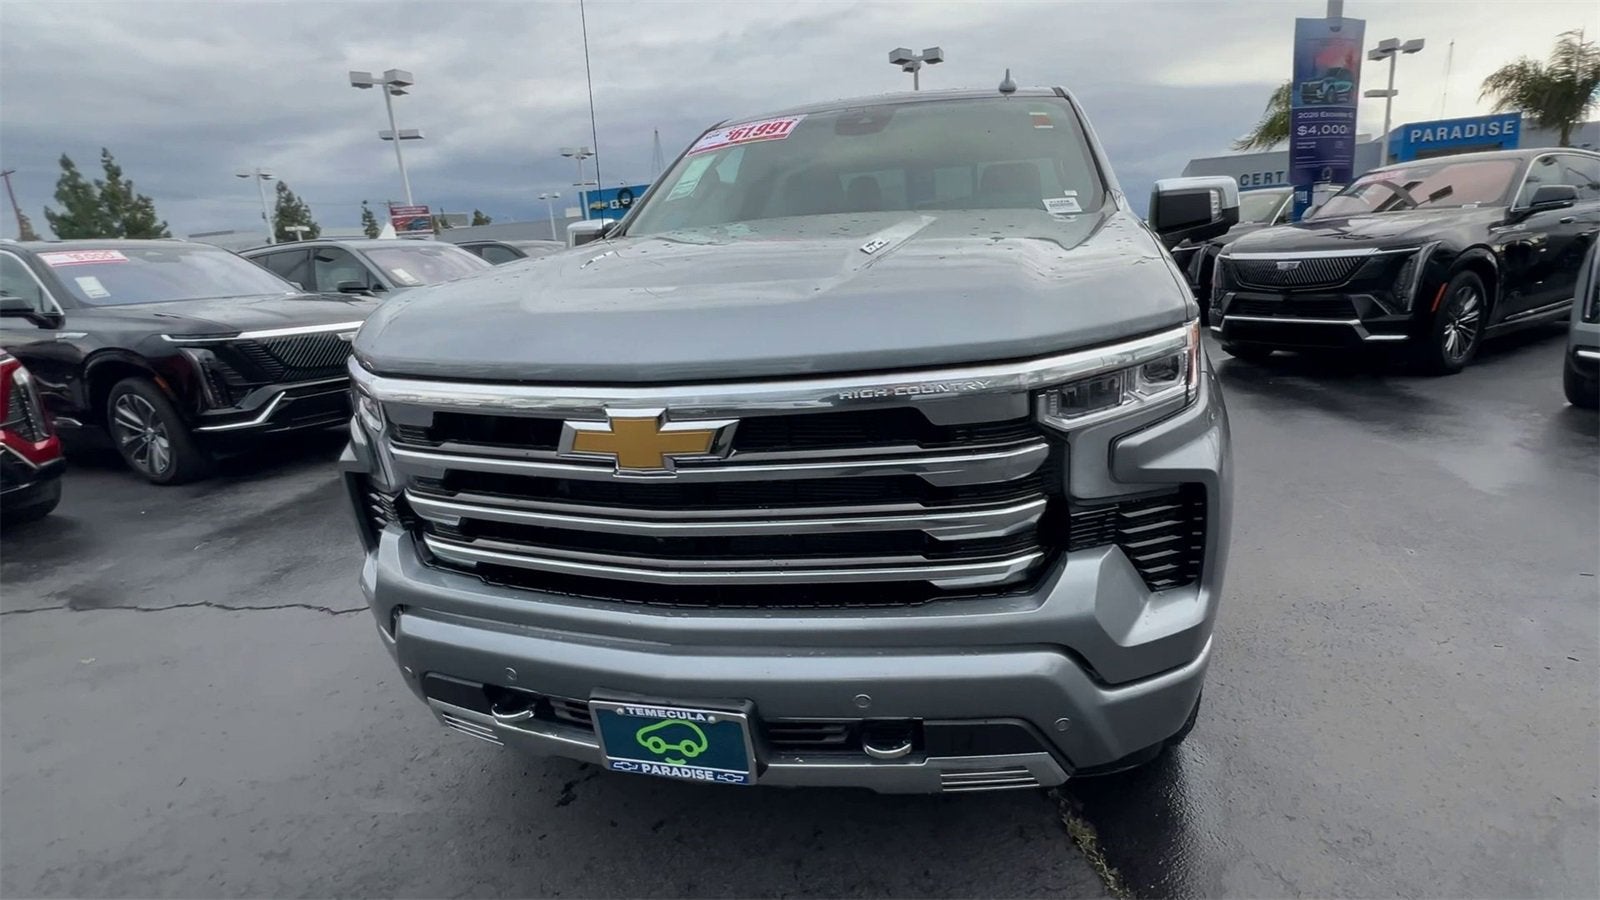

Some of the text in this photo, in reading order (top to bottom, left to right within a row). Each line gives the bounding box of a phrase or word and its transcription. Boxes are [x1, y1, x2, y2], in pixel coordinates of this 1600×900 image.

[1410, 120, 1516, 144] PARADISE
[1240, 170, 1285, 186] CERT
[838, 379, 992, 400] HIGH COUNTRY
[626, 706, 706, 722] TEMECULA
[641, 763, 715, 782] PARADISE
